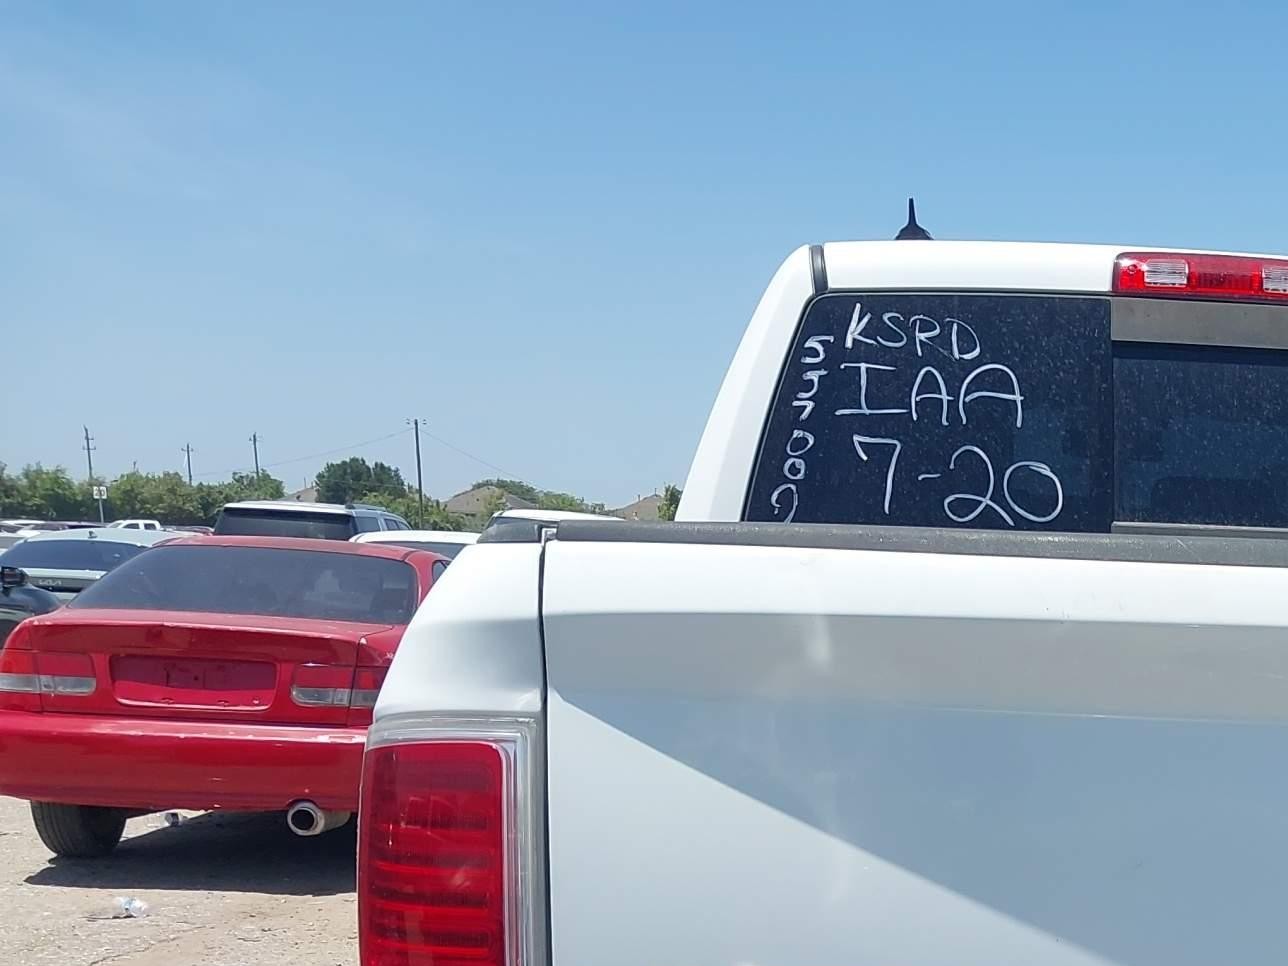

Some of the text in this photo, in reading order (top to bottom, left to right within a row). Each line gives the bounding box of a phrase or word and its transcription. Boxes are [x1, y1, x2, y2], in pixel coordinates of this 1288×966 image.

[844, 302, 981, 361] KSRD
[834, 362, 1025, 428] IAA
[852, 434, 1064, 527] 7-20
